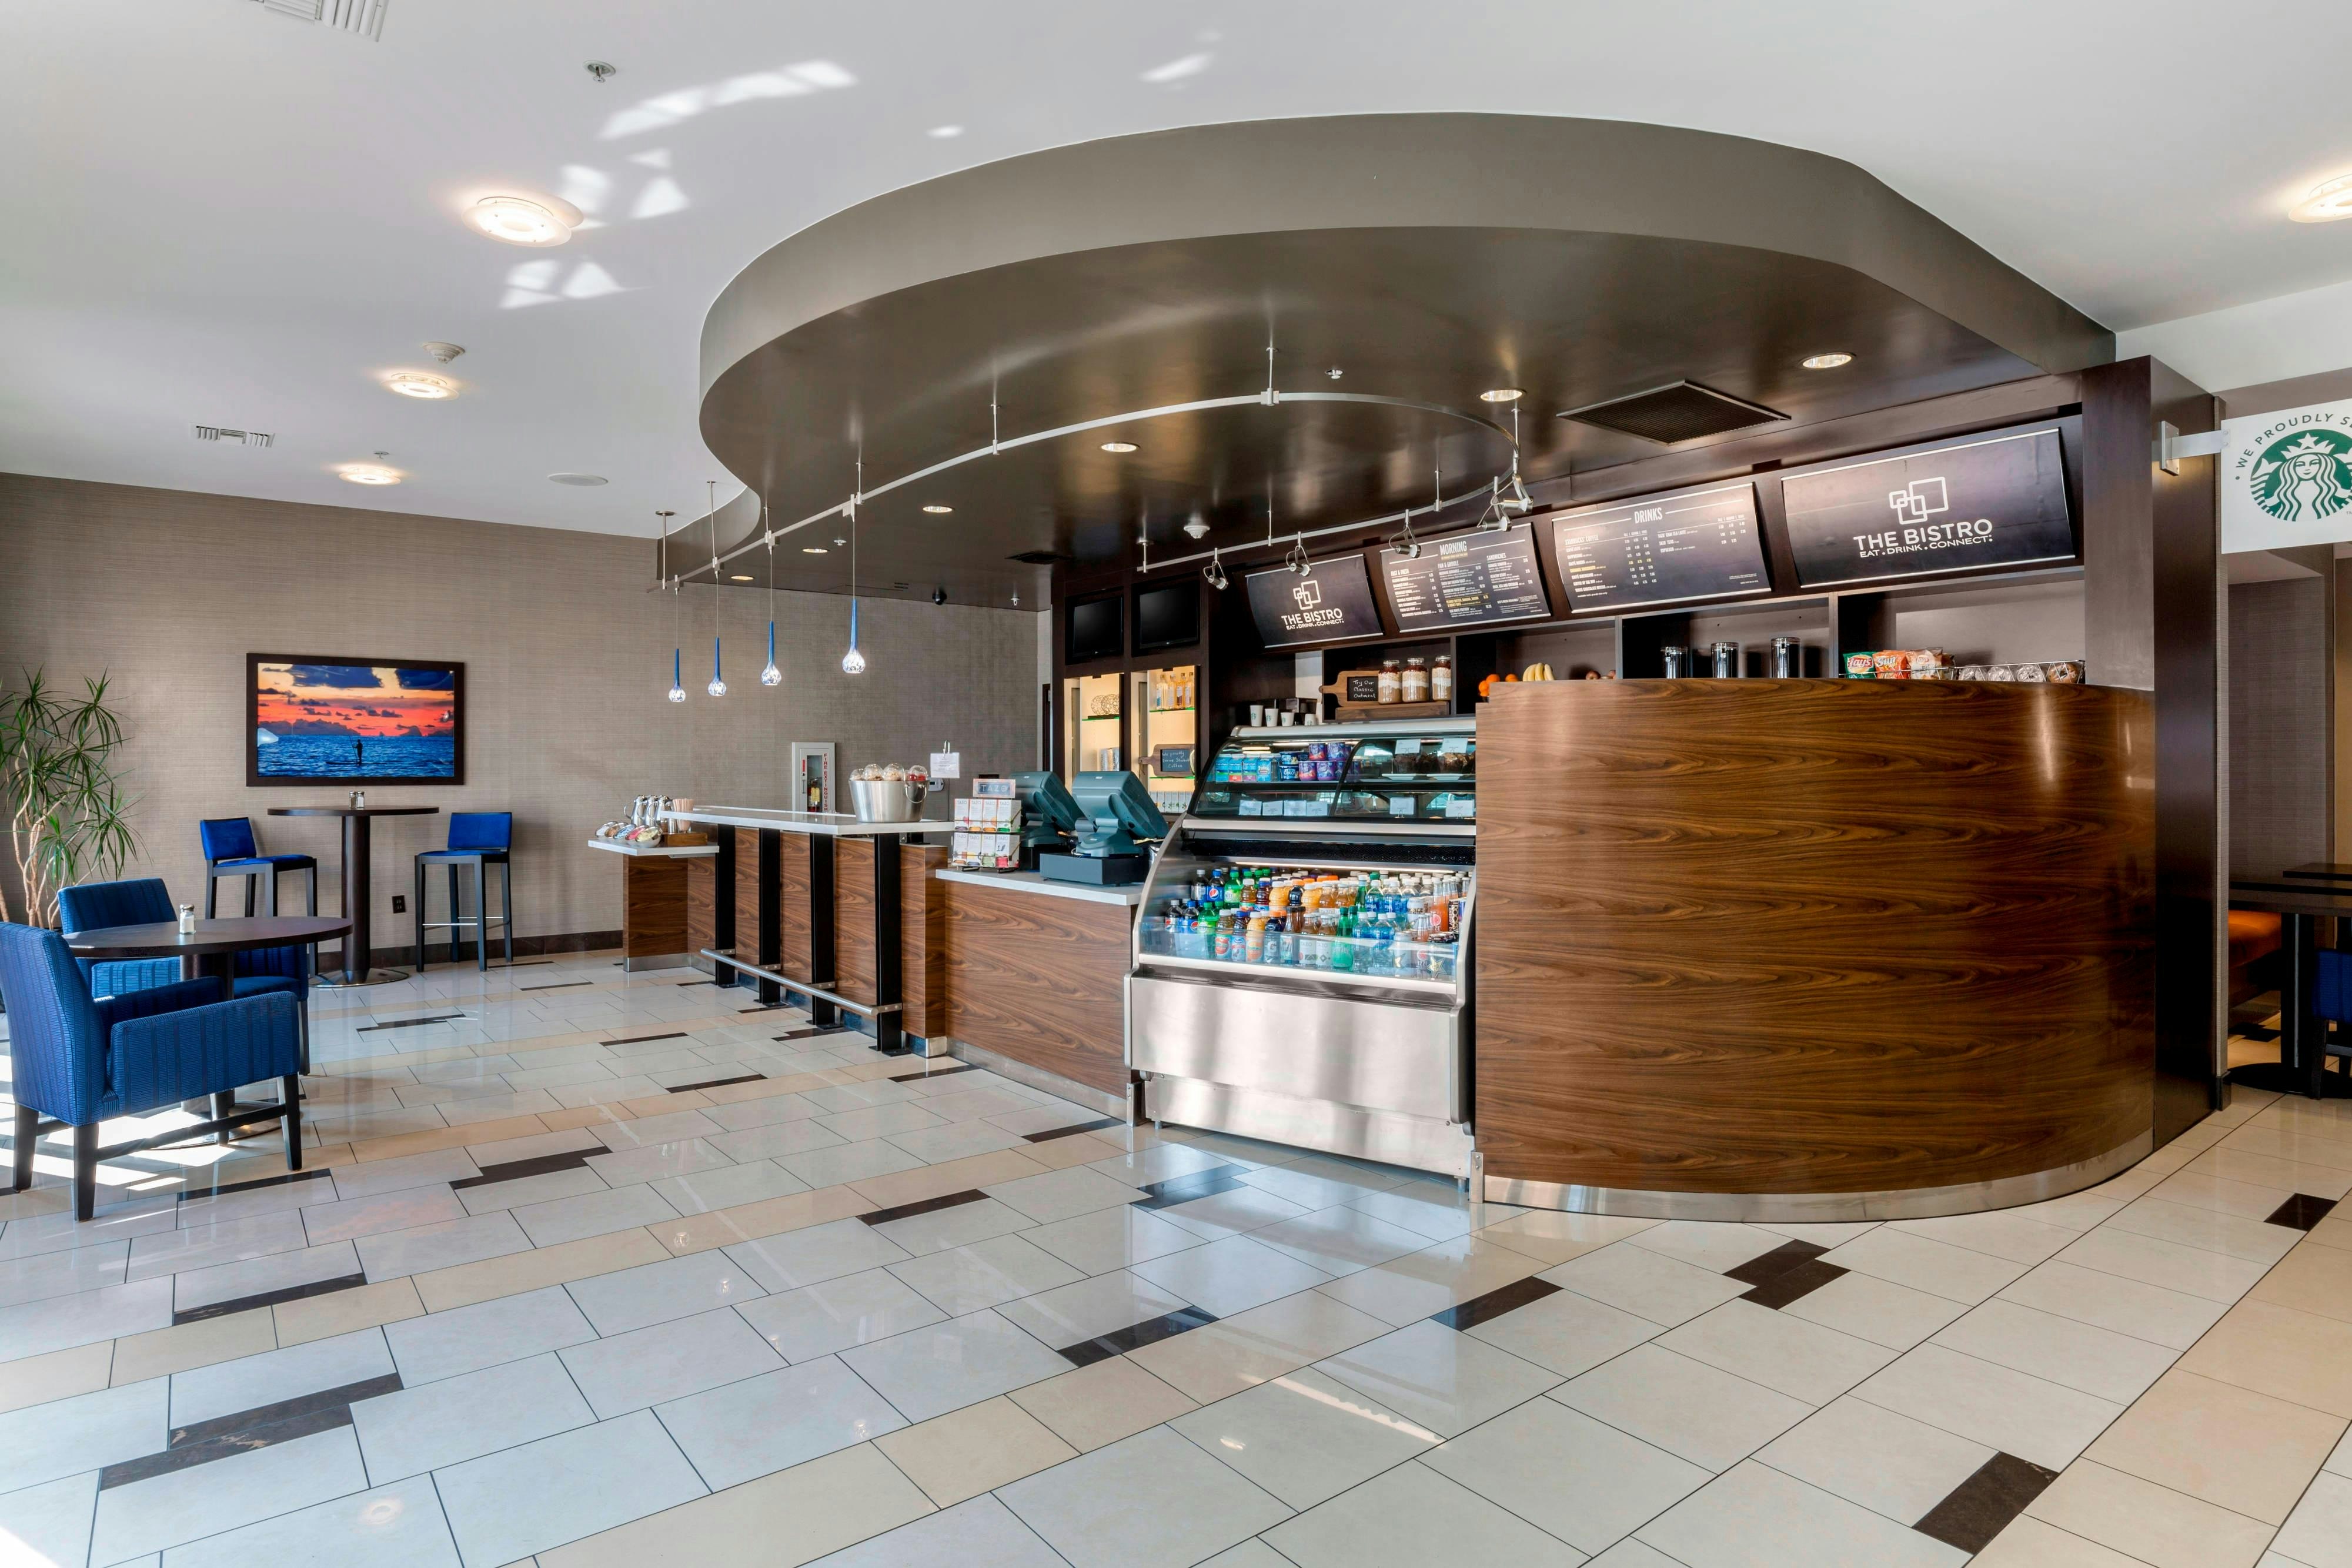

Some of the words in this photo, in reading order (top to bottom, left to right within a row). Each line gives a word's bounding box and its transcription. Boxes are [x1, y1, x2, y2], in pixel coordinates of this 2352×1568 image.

[2236, 449, 2254, 468] WE
[2254, 413, 2334, 445] PROUDLY
[2340, 416, 2352, 428] S
[1635, 507, 1662, 523] DRINKS
[1853, 531, 1898, 550] THE
[1904, 519, 1993, 544] BISTRO
[1439, 540, 1467, 555] MORNING
[1281, 613, 1303, 625] THE
[1304, 608, 1342, 623] BISTRO
[980, 784, 1008, 793] TAZO
